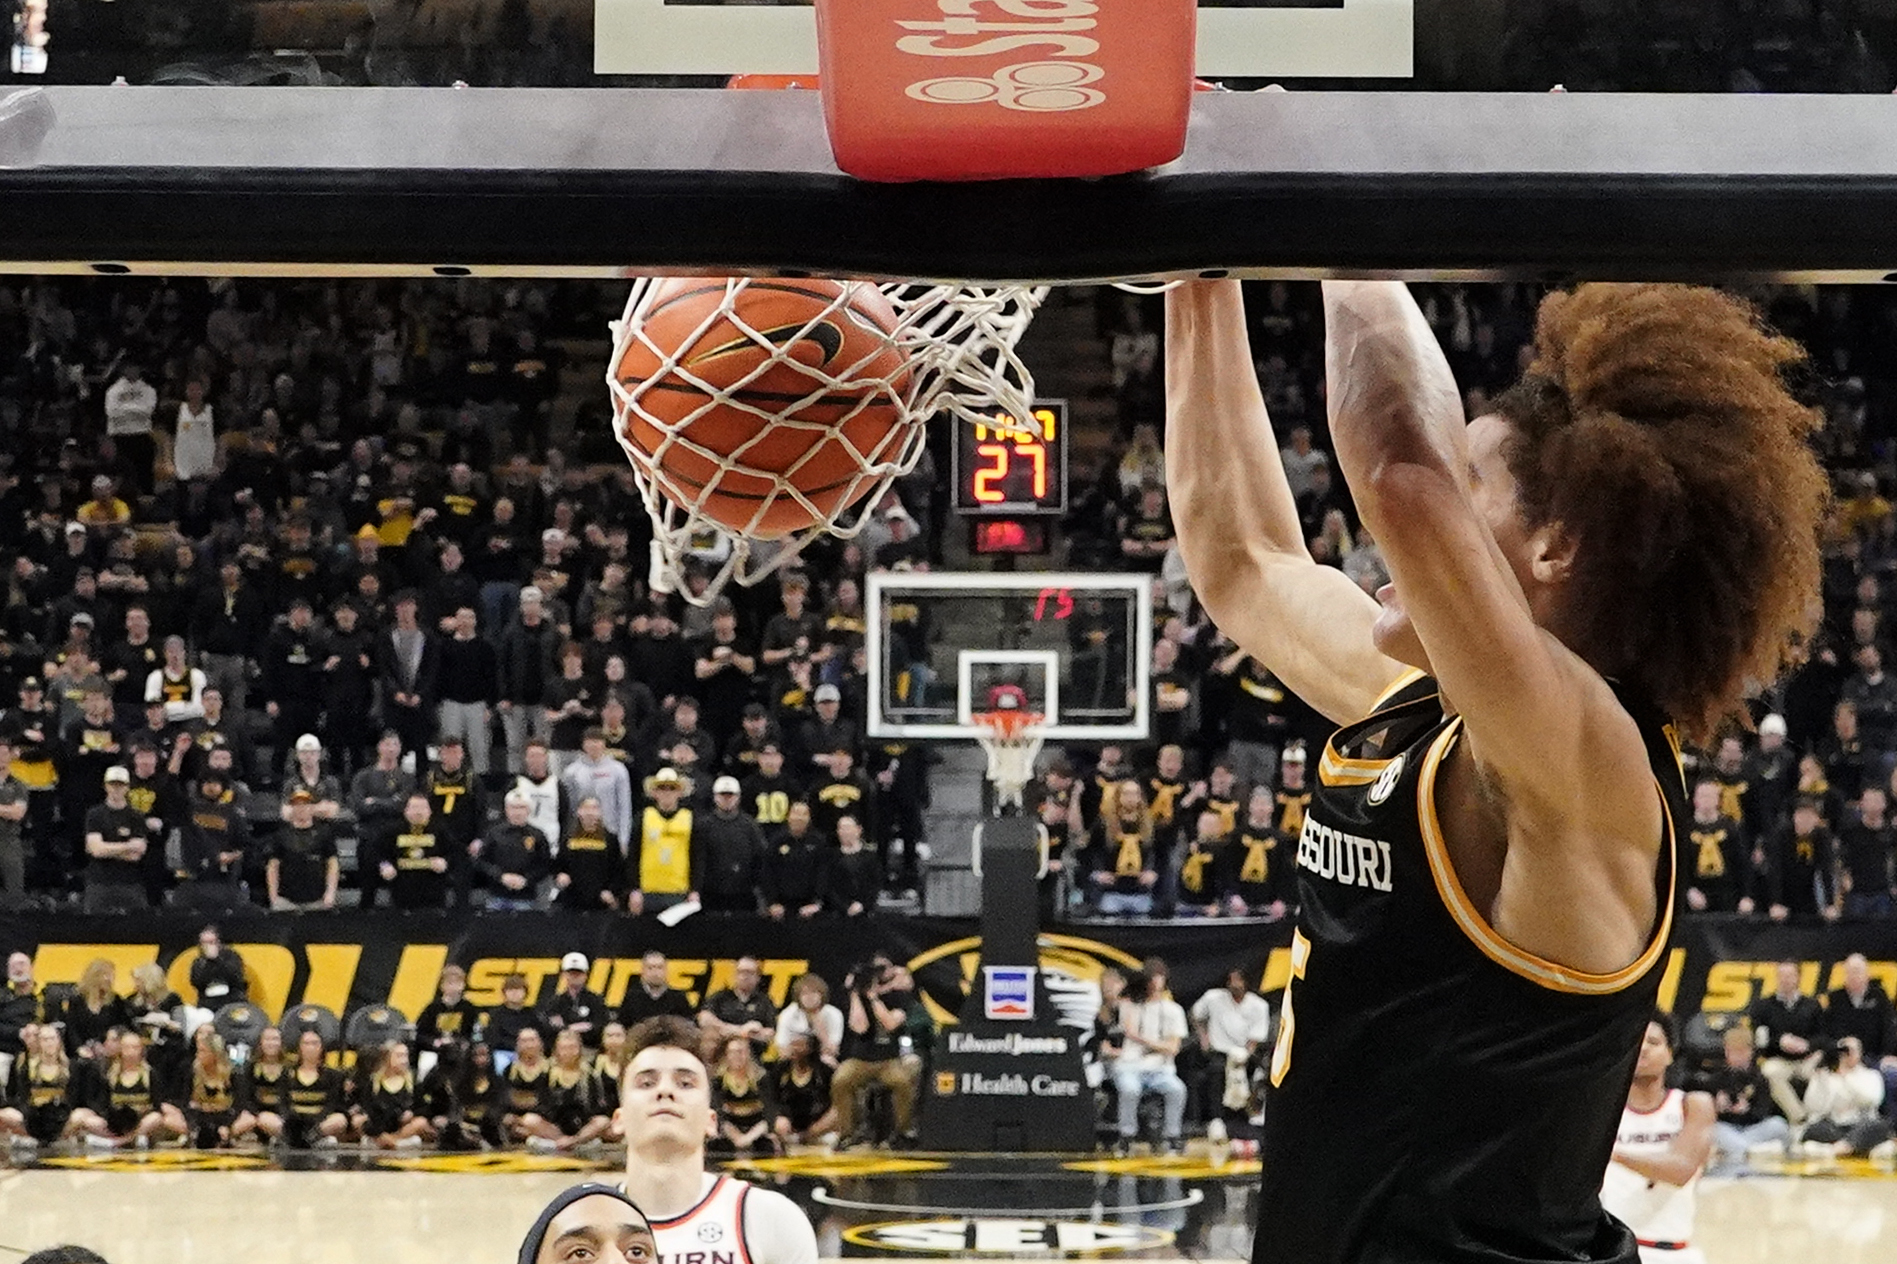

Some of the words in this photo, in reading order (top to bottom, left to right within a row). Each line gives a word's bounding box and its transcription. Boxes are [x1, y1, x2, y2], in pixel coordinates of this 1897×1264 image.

[973, 443, 1046, 502] 27
[755, 791, 789, 824] 10
[961, 1072, 1029, 1095] Health
[1031, 1074, 1081, 1096] Care
[864, 1220, 1148, 1250] SEC
